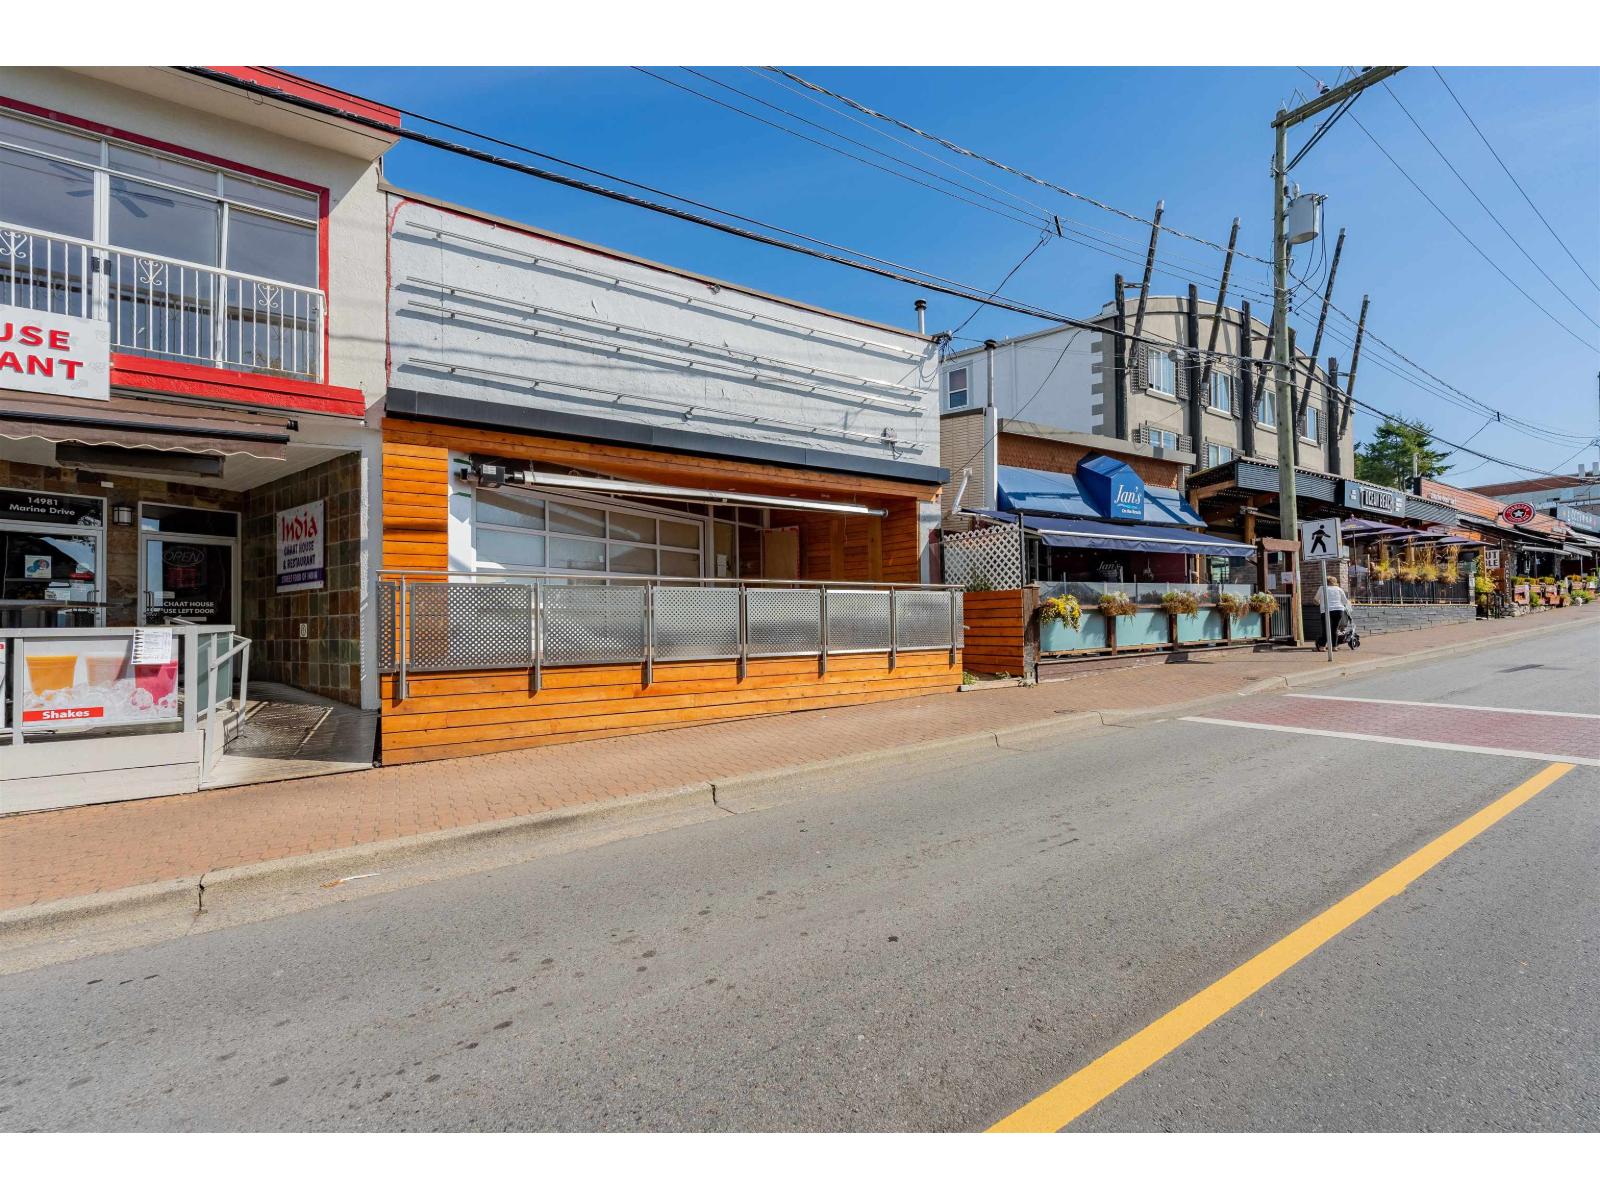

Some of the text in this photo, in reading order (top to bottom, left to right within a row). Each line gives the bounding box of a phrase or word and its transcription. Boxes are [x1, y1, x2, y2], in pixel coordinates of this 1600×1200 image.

[0, 351, 84, 380] ANT
[27, 496, 58, 506] 14981
[1113, 484, 1142, 505] Jan's
[9, 503, 76, 516] Marine Drive
[283, 540, 314, 557] CHAAT HOUSE
[164, 551, 204, 561] OPEN
[287, 554, 316, 569] RESTAURANT
[42, 709, 90, 720] Shakes
